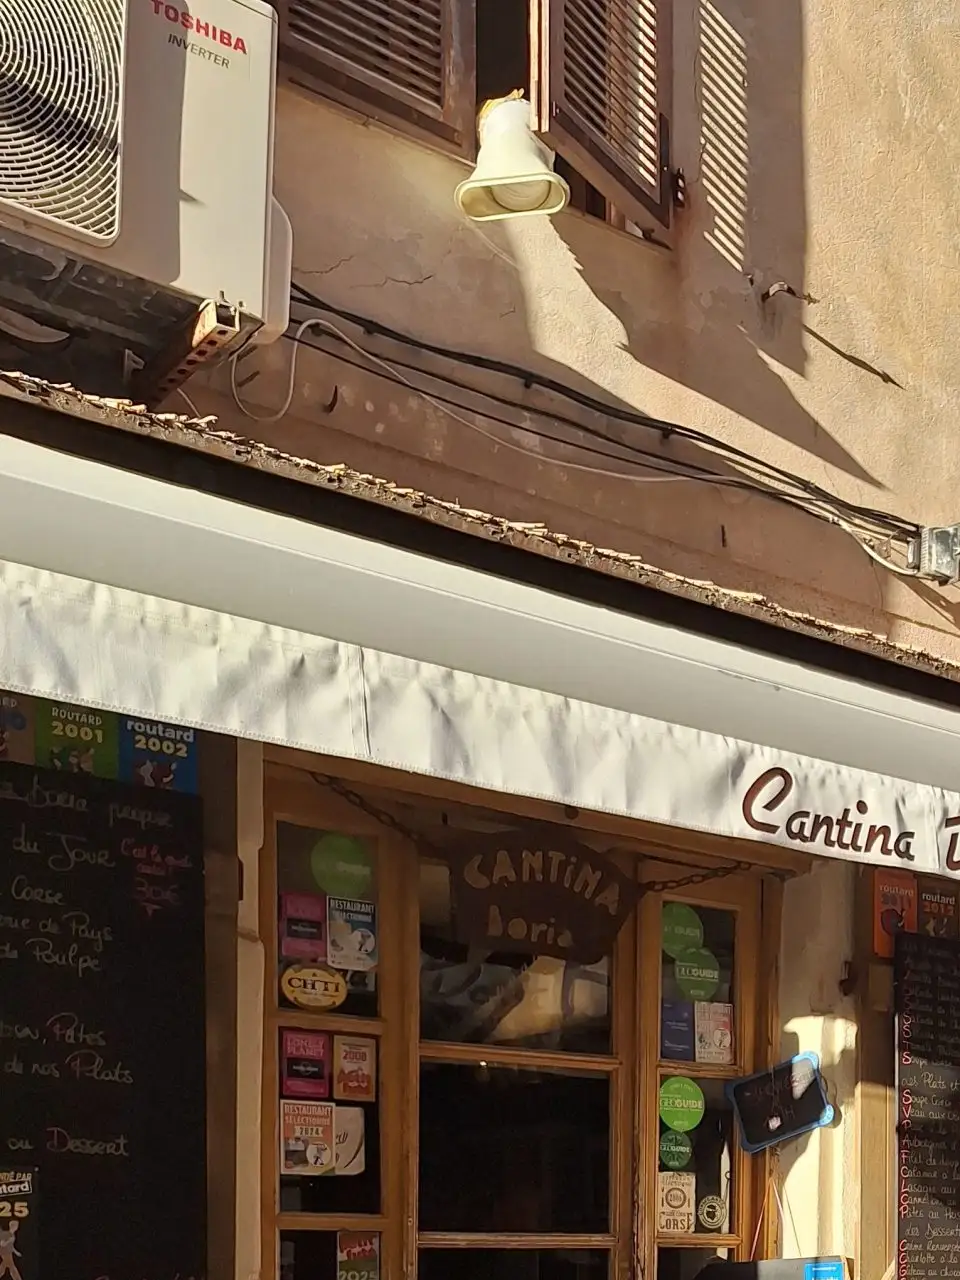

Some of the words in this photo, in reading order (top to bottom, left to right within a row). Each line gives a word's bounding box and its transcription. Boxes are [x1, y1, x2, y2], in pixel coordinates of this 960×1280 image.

[151, 0, 247, 54] TOSHIBA
[168, 34, 230, 68] INVERTER
[52, 707, 102, 726] ROUTARD
[52, 720, 105, 743] 2001
[126, 719, 195, 743] routard
[134, 734, 188, 758] 2002
[742, 766, 915, 862] Cantina
[922, 893, 956, 905] routard
[24, 937, 101, 978] Poulpe
[284, 1103, 331, 1115] RESTAURANT
[46, 1126, 129, 1157] Dessert
[0, 1200, 30, 1218] 25
